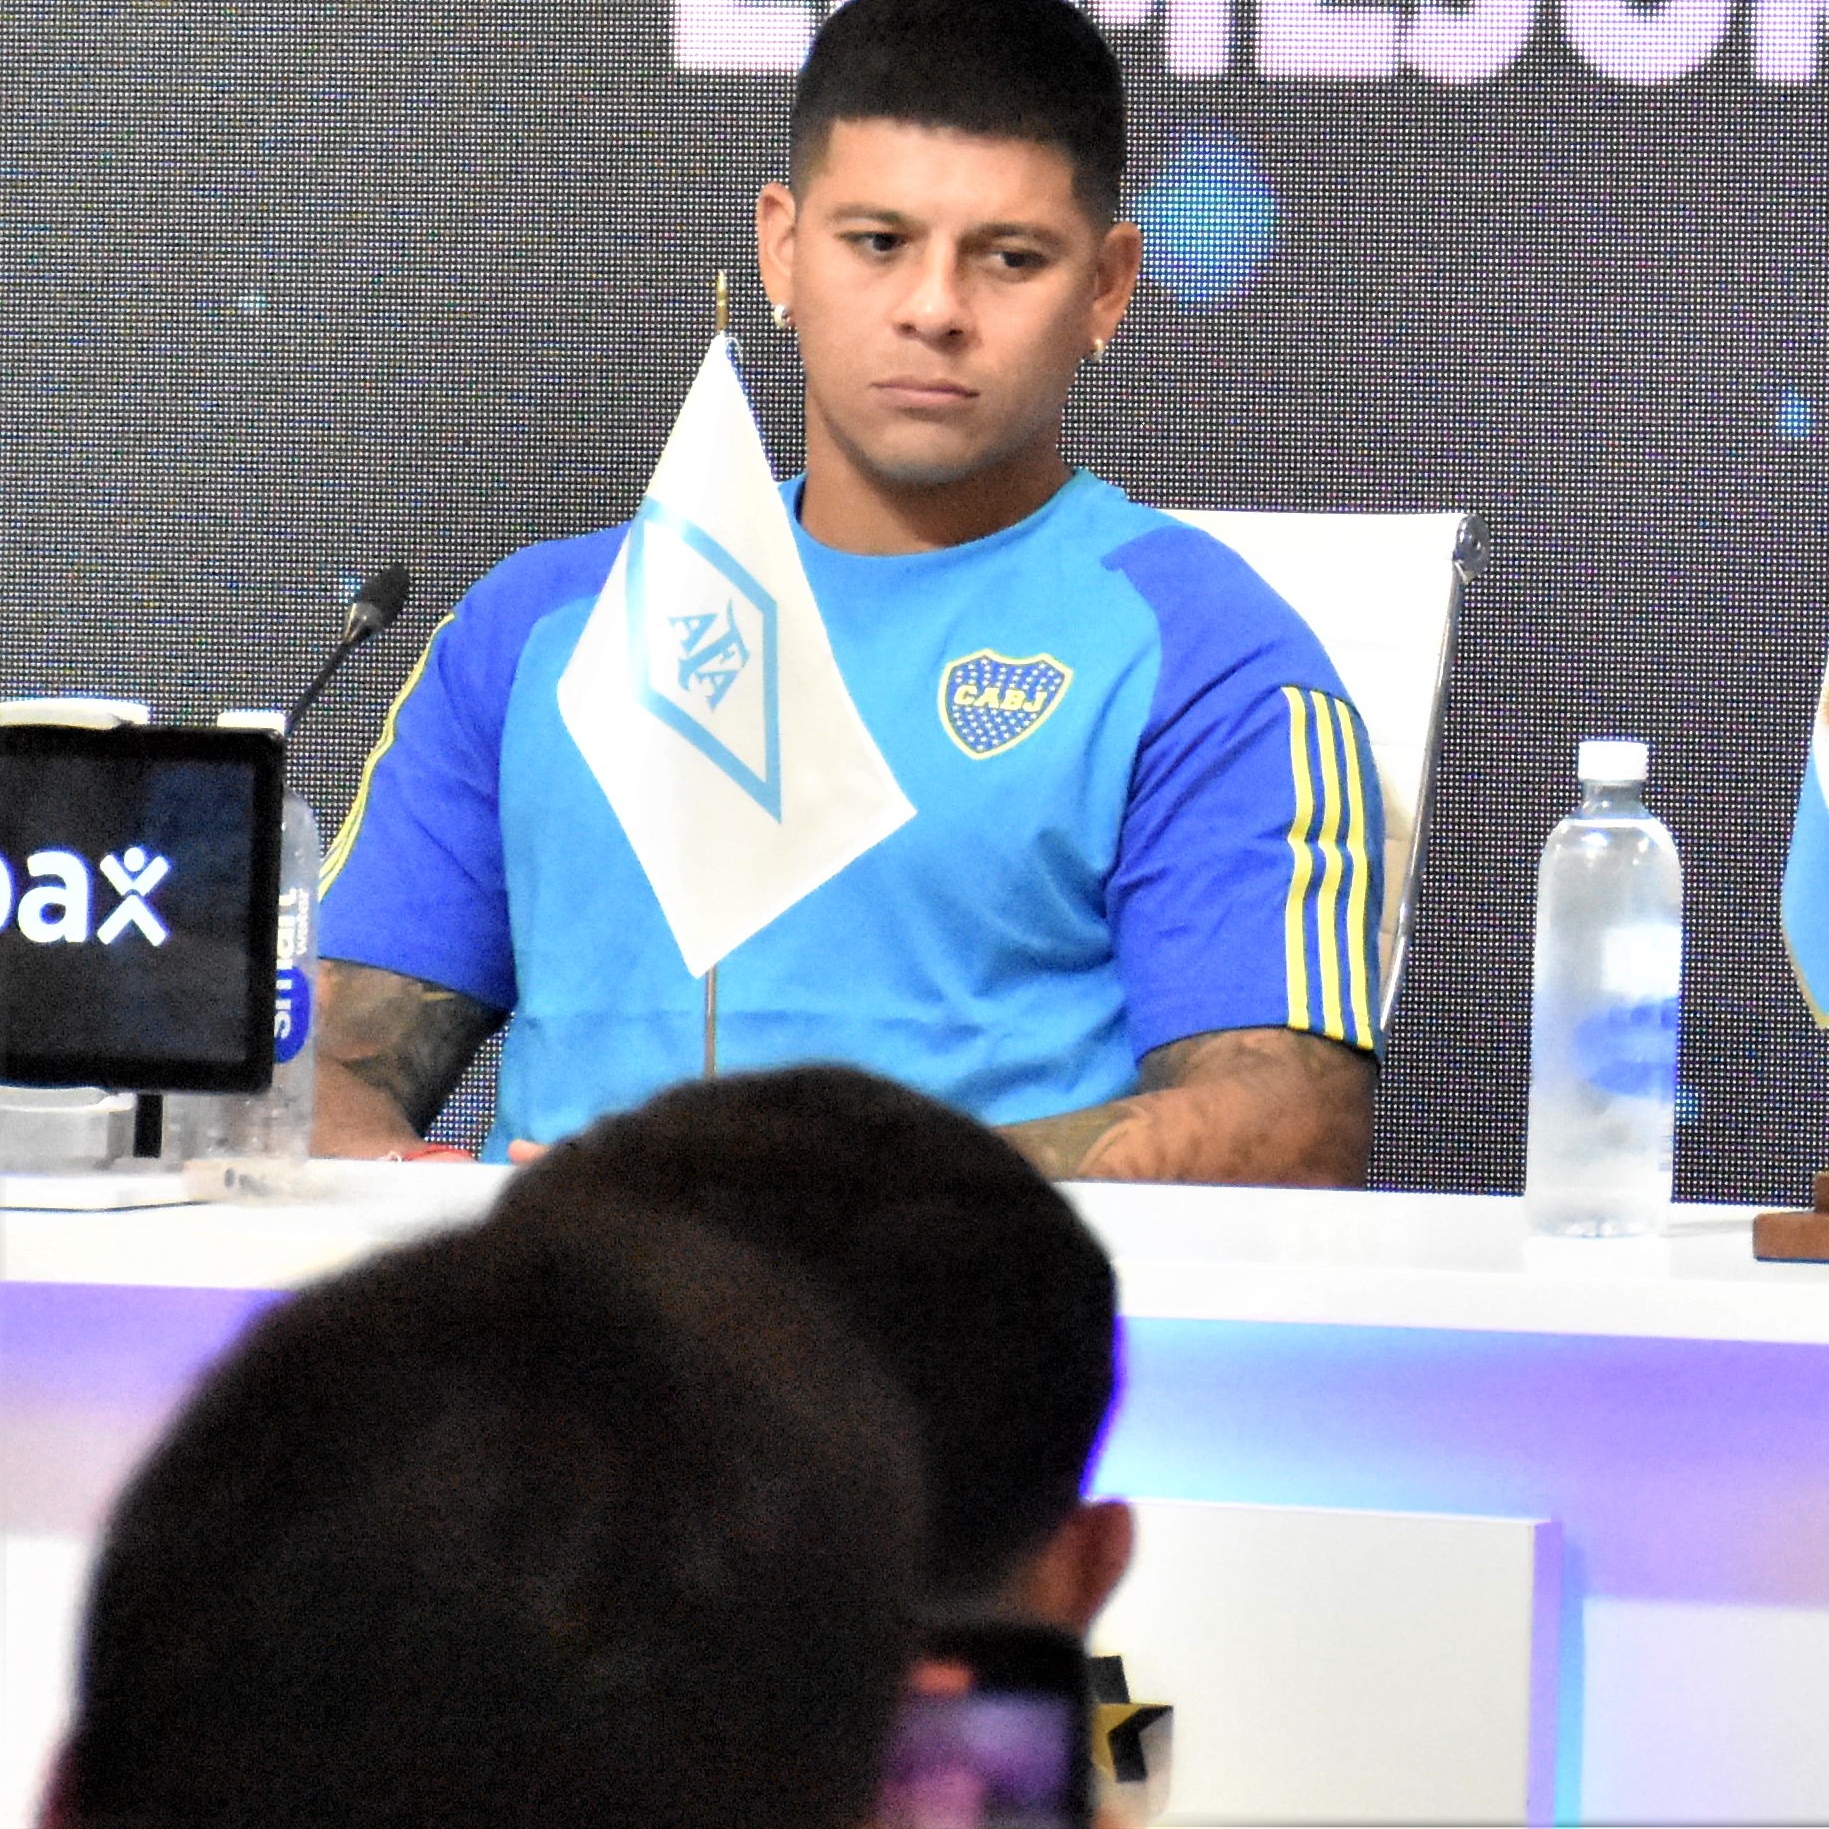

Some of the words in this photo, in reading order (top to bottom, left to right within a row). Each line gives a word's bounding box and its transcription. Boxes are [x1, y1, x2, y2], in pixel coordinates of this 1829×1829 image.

[667, 598, 750, 713] AFA
[954, 684, 1048, 713] CABJ
[0, 847, 170, 947] ax
